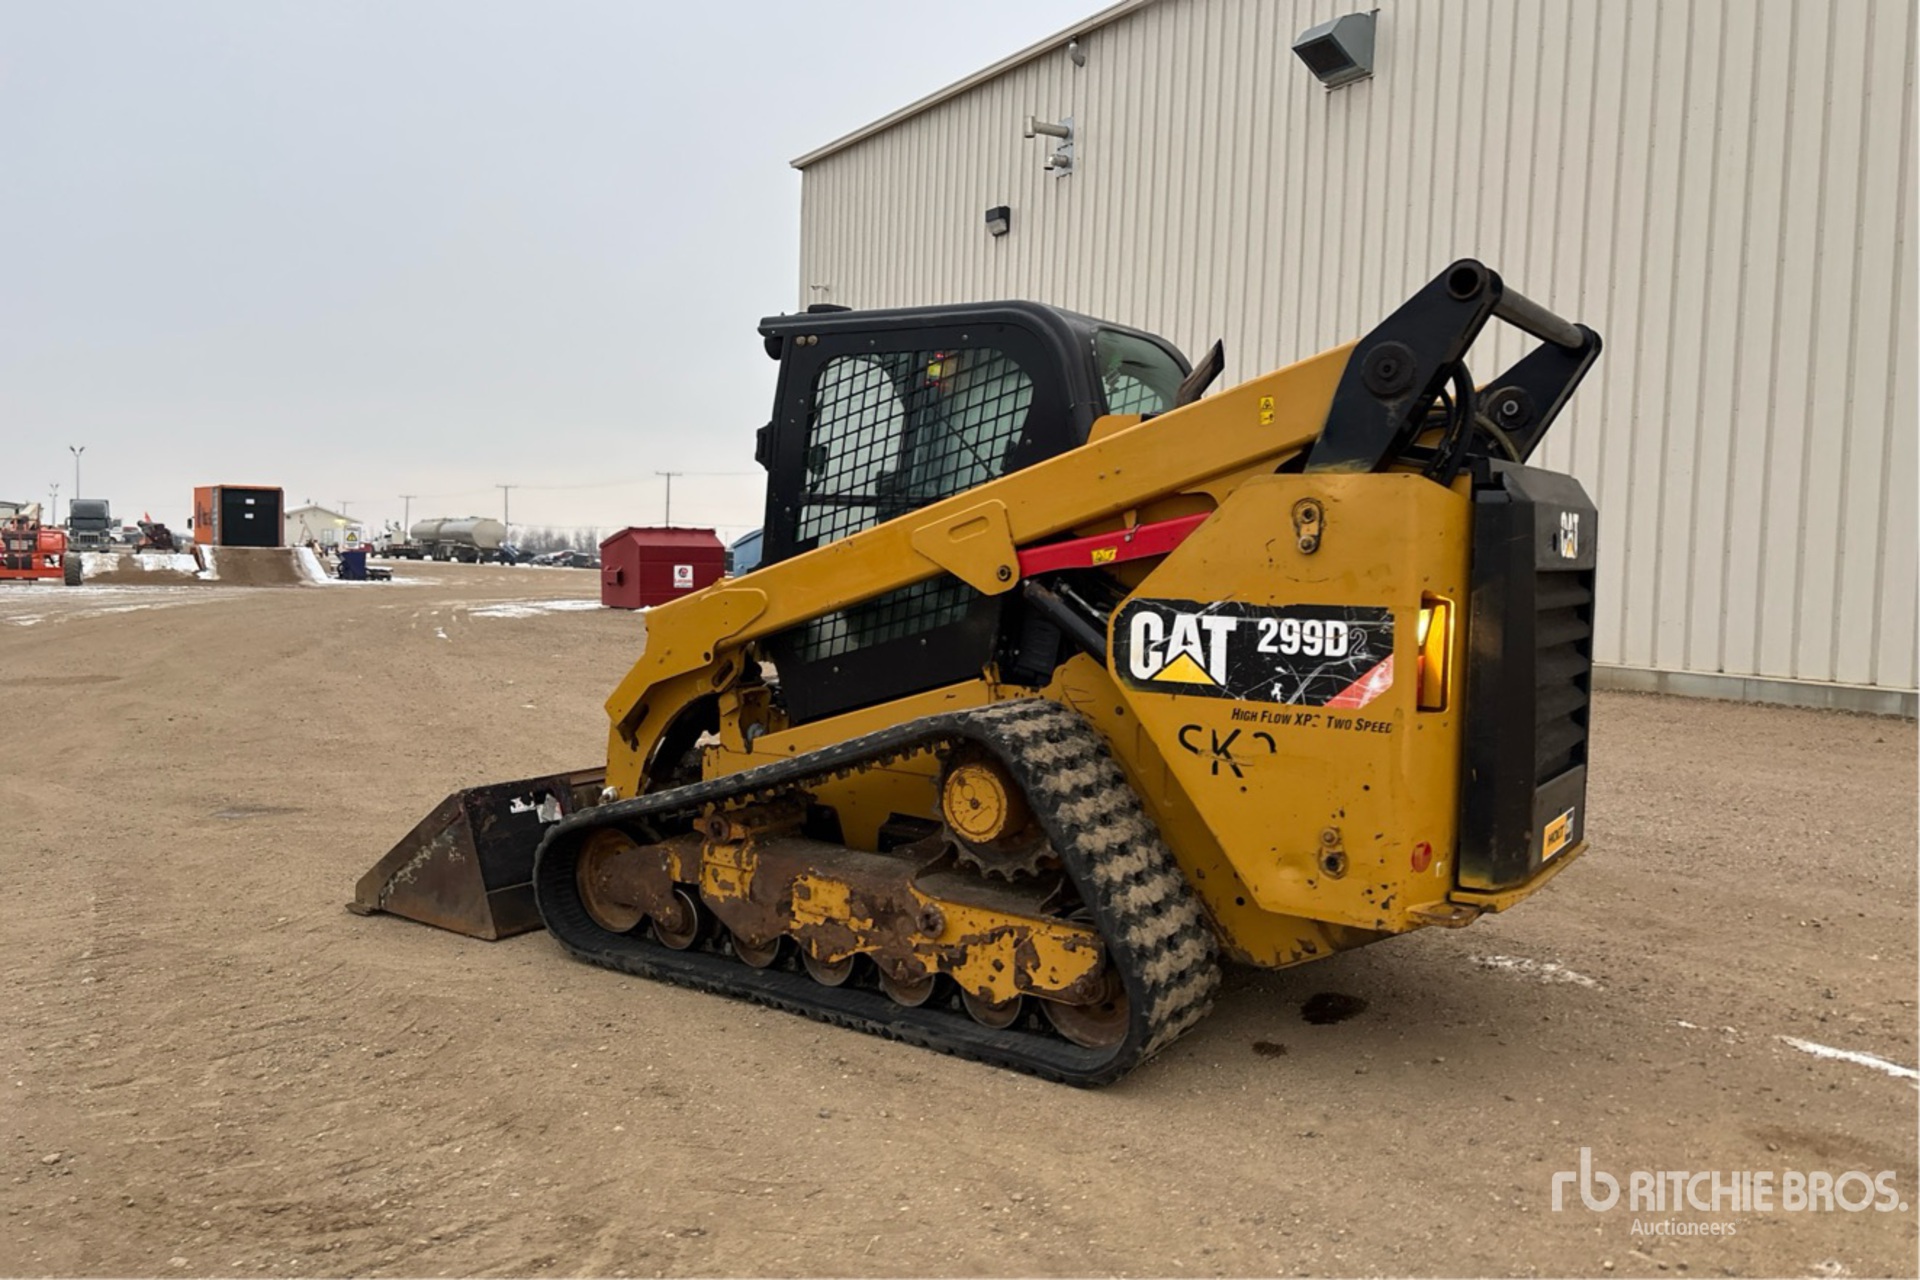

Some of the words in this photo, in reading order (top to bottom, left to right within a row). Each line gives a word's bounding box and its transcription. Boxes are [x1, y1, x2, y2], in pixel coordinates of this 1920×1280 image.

[1560, 511, 1579, 559] CAT
[1129, 611, 1237, 686] CAT
[1231, 708, 1258, 722] HIGH
[1260, 710, 1291, 725] FLOW
[1326, 715, 1352, 731] TWO
